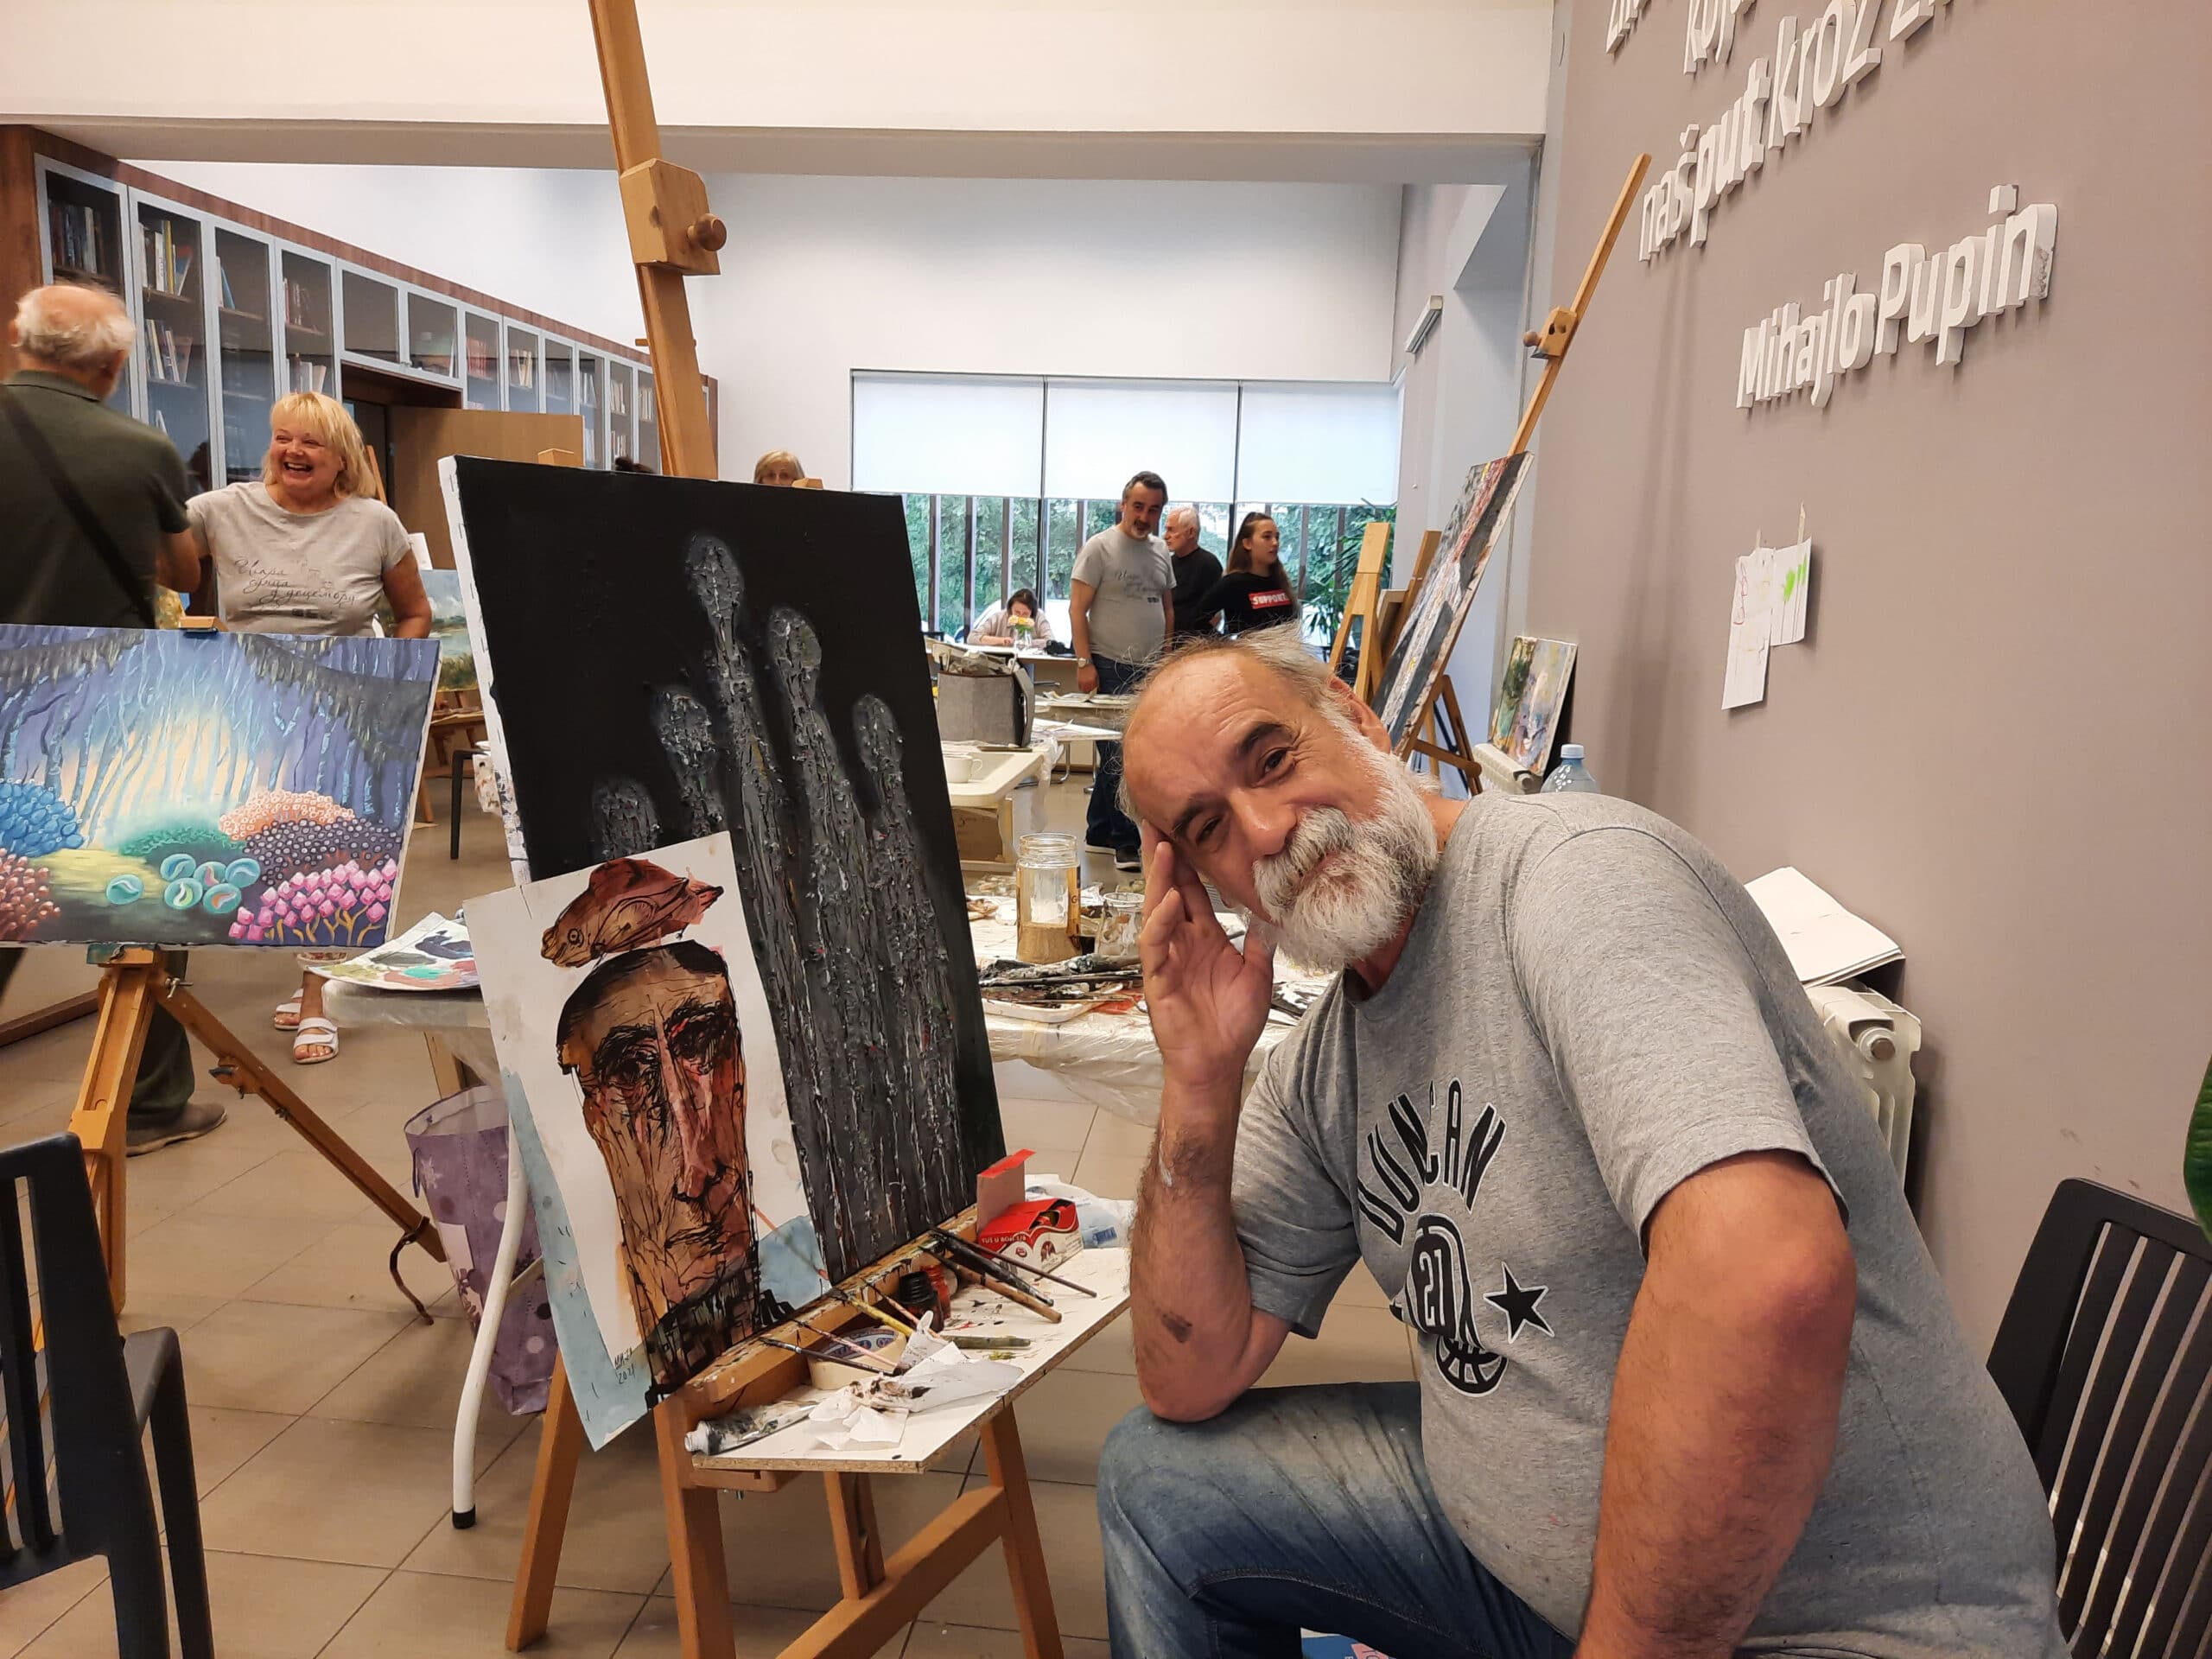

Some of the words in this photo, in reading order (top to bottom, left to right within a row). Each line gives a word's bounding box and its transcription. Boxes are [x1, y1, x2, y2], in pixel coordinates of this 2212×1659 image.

[1639, 124, 1700, 261] naš
[1689, 57, 1771, 249] put
[1768, 0, 1883, 150] kroz
[1736, 271, 1878, 410] Mihajlo
[1874, 184, 2058, 366] Pupin
[1419, 1248, 1446, 1326] 21
